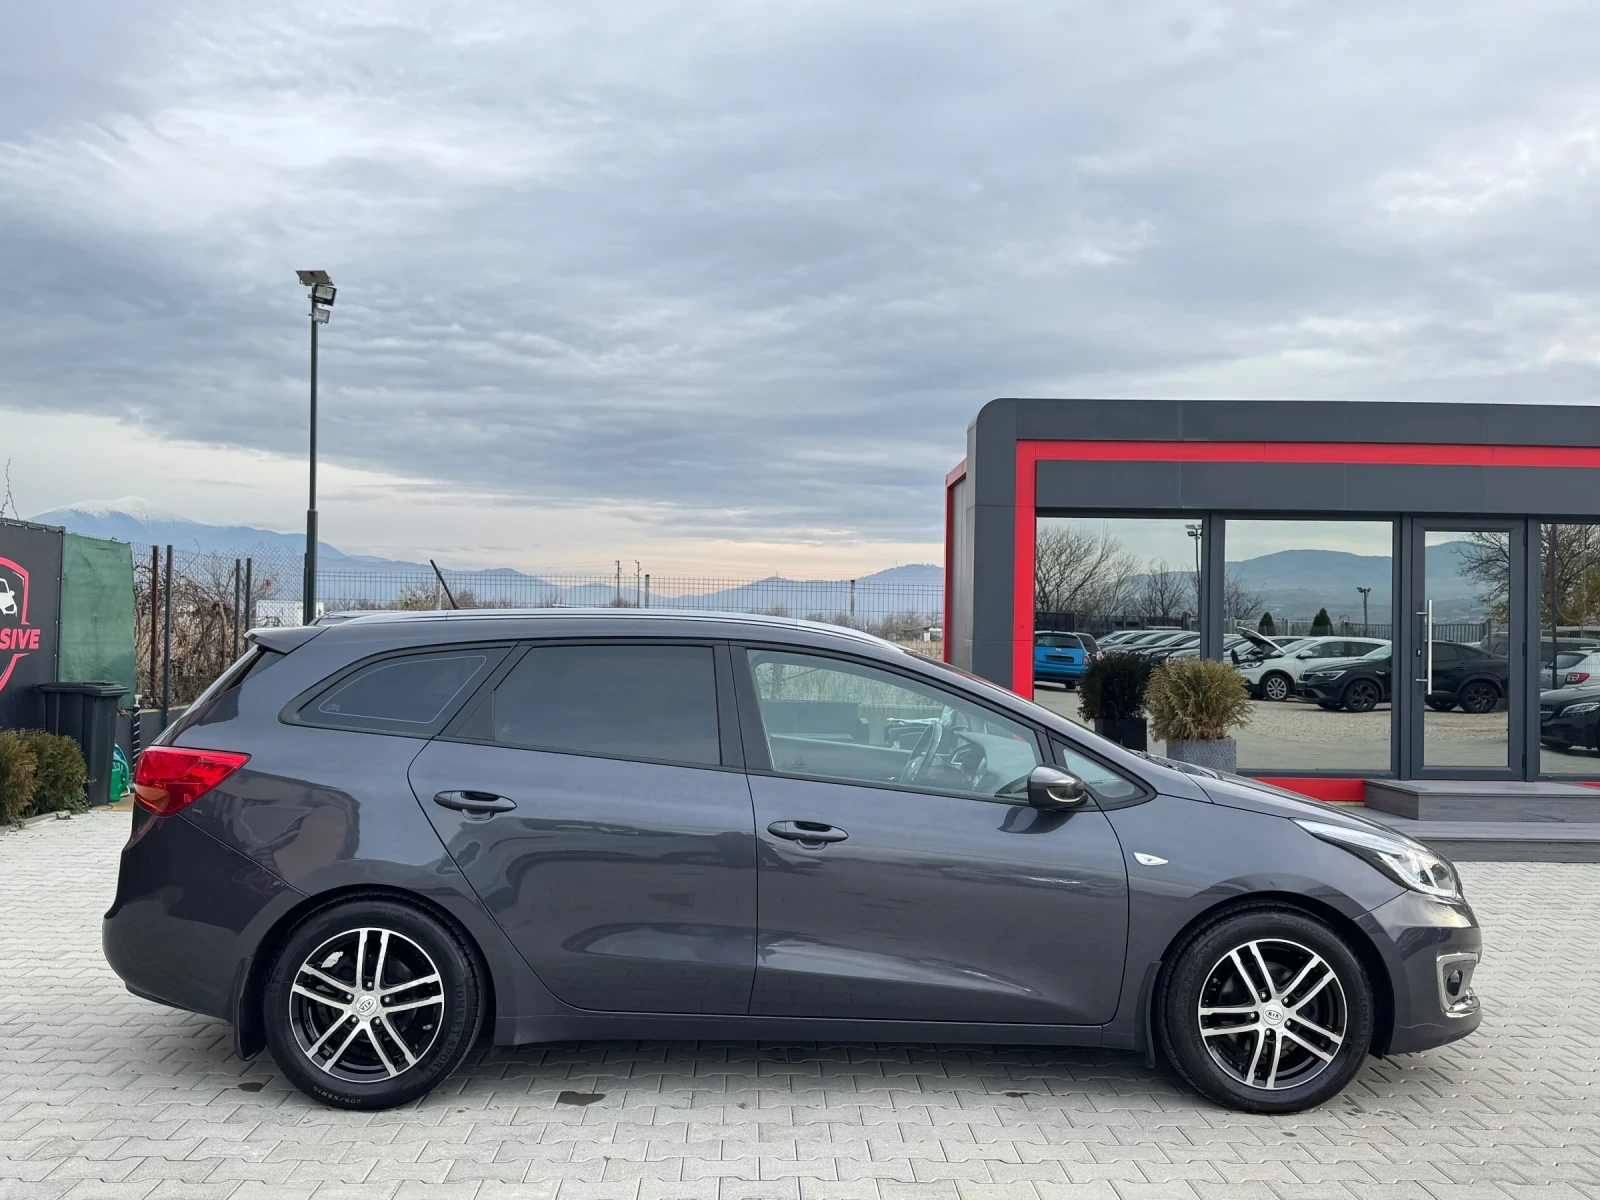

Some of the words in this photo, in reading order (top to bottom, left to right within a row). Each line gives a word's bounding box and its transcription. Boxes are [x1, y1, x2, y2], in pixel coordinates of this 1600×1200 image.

[0, 628, 40, 650] SIVE
[452, 981, 466, 1037] TOMKET
[426, 1038, 457, 1077] SPORT
